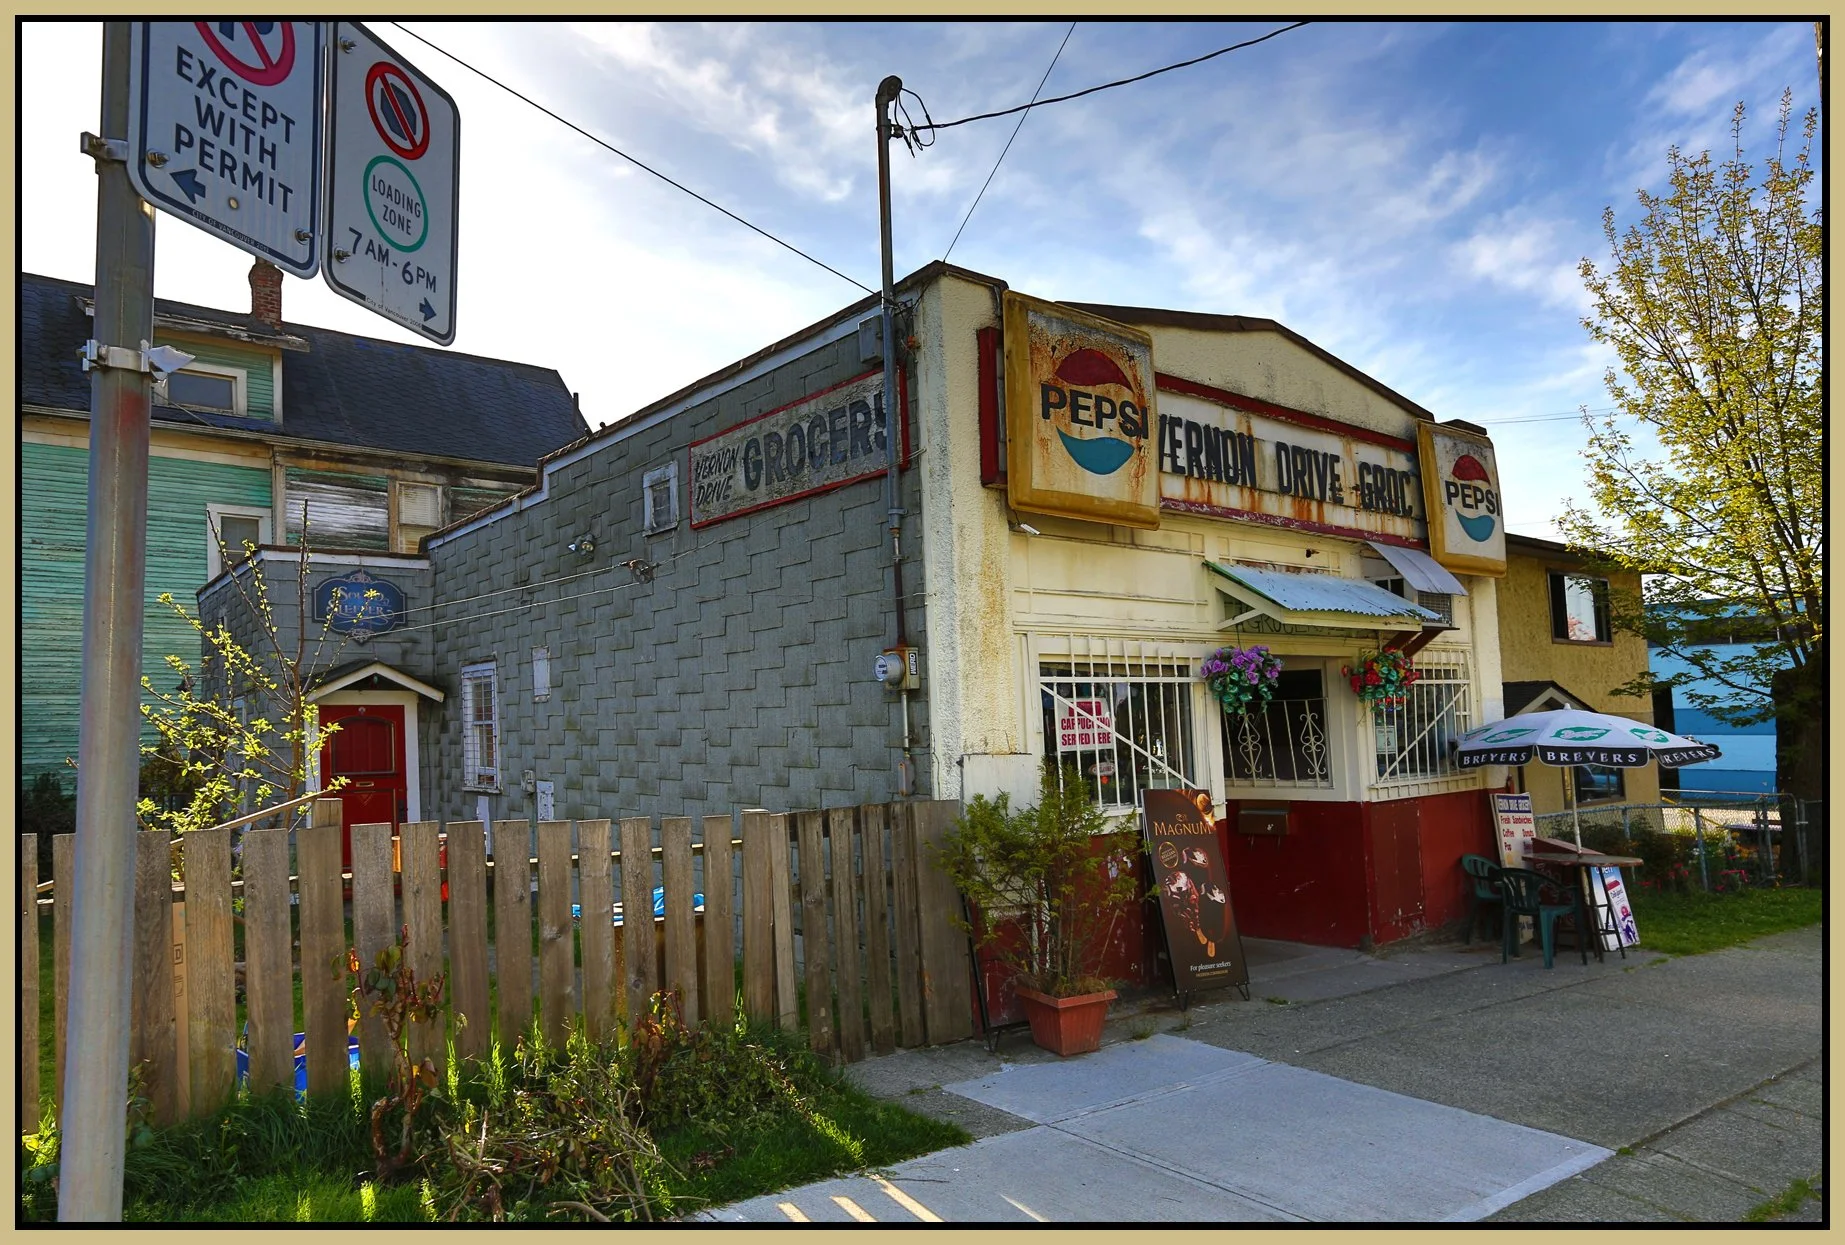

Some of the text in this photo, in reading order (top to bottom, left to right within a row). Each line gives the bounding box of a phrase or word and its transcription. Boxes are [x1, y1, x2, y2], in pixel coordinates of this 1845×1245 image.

[176, 45, 296, 145] EXCEPT
[194, 94, 277, 171] WITH
[174, 122, 294, 213] PERMIT
[372, 174, 422, 218] LOADING
[219, 224, 256, 246] VANCOUVER
[382, 204, 412, 236] ZONE
[385, 306, 409, 322] Vancouver
[1041, 383, 1149, 440] PEPSI
[695, 444, 740, 483] VERNON
[1275, 441, 1344, 504] DRIVE
[1358, 461, 1413, 517] GROC
[696, 475, 734, 508] DRIVE
[1445, 480, 1500, 517] PEPSI
[1464, 752, 1527, 765] BREYERS
[1547, 751, 1638, 763] BREYERS
[1153, 821, 1212, 836] MAGNUM
